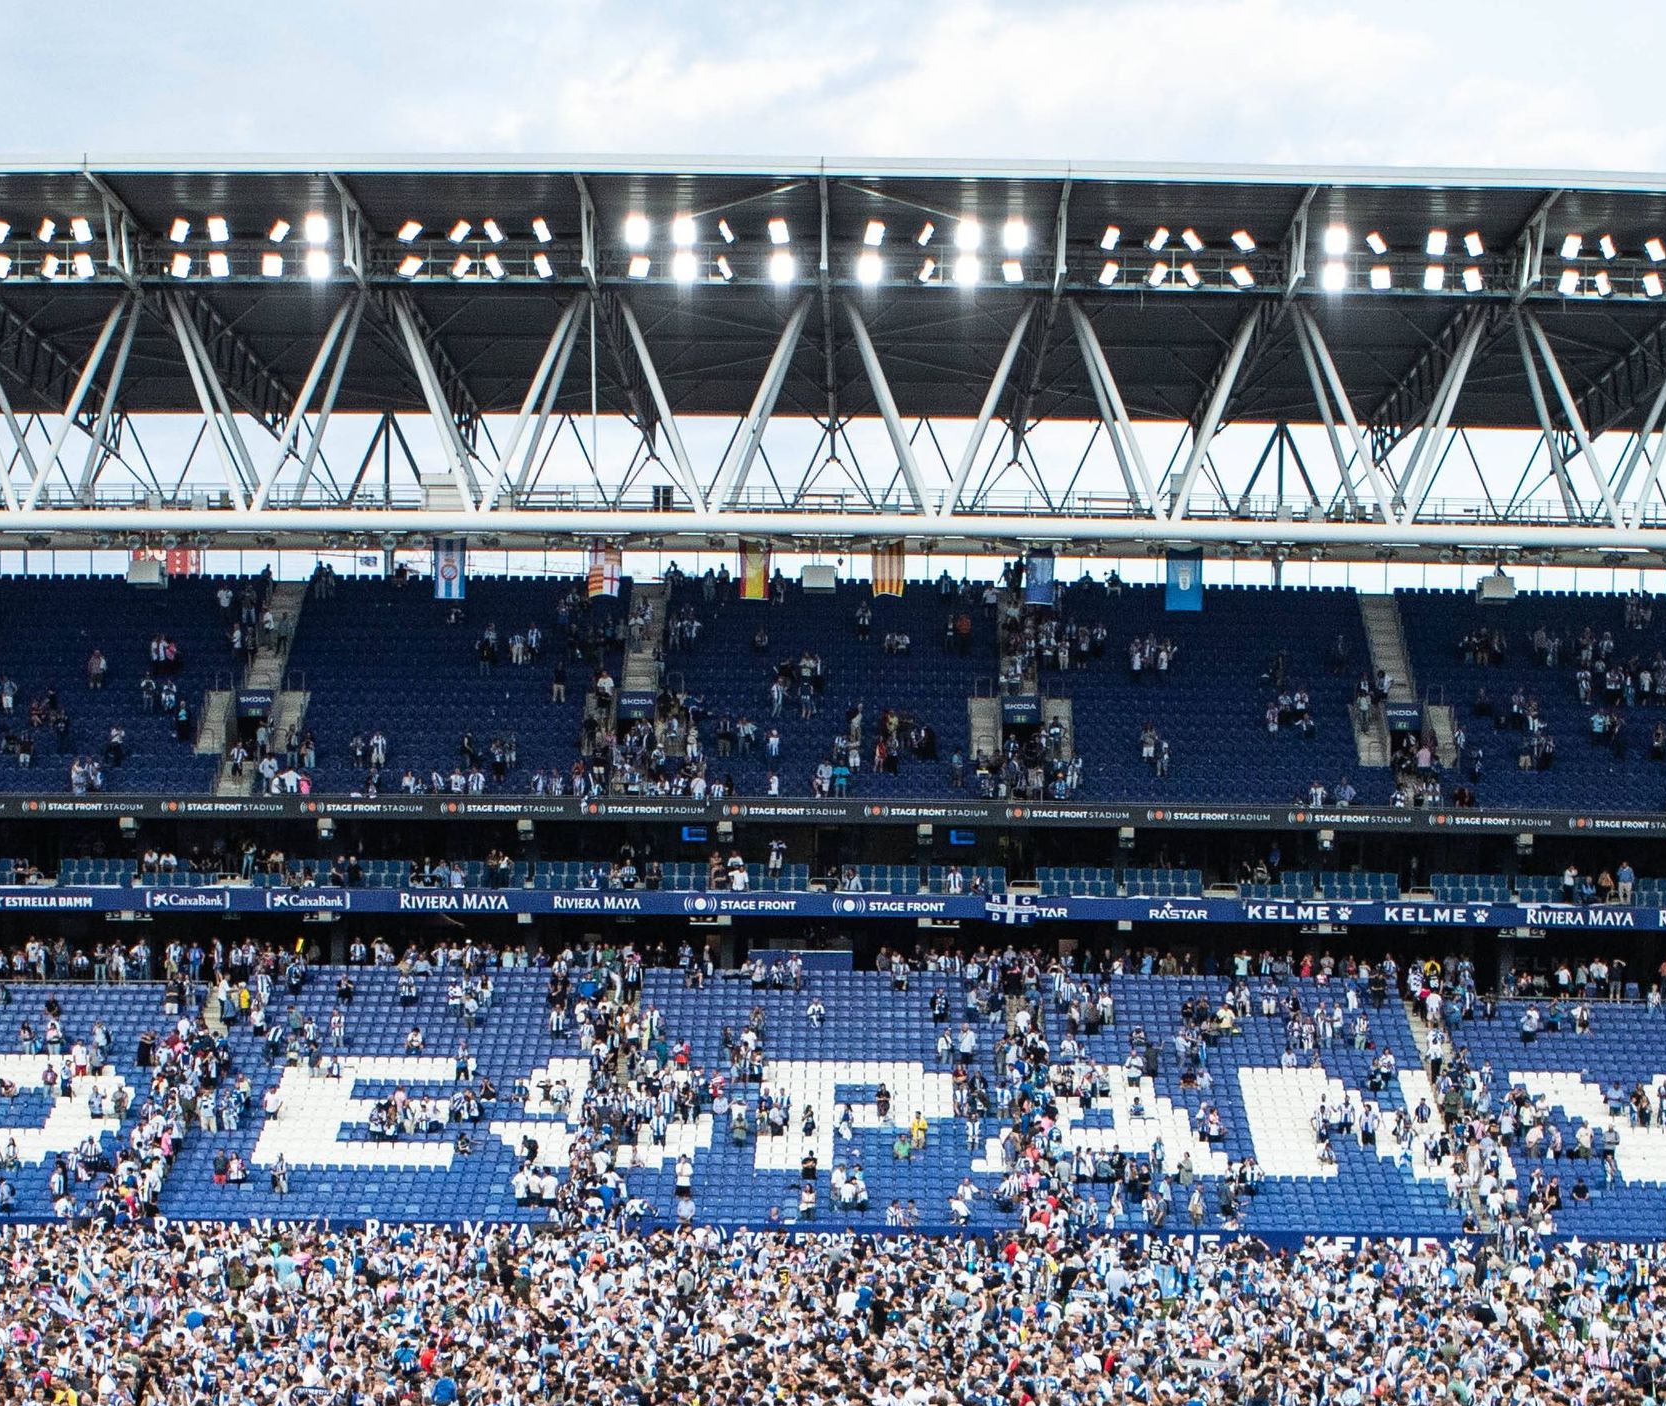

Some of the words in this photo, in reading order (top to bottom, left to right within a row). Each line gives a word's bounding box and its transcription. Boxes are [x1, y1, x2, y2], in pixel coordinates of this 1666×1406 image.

[5, 897, 55, 907] ESTRELLA
[56, 897, 92, 907] DAMM
[169, 894, 223, 908] CaixaBank
[289, 894, 343, 908] CaixaBank
[400, 893, 458, 909] RIVIERA
[463, 894, 509, 909] MAYA
[554, 896, 600, 909] RIVIERA
[604, 897, 640, 909] MAYA
[721, 900, 756, 909] STAGE
[759, 901, 796, 910] FRONT
[869, 902, 904, 911] STAGE
[907, 903, 945, 911] FRONT
[1245, 903, 1329, 920] KELME
[1385, 908, 1466, 922] KELME
[1525, 907, 1584, 924] RIVIERA
[1589, 910, 1634, 926] MAYA
